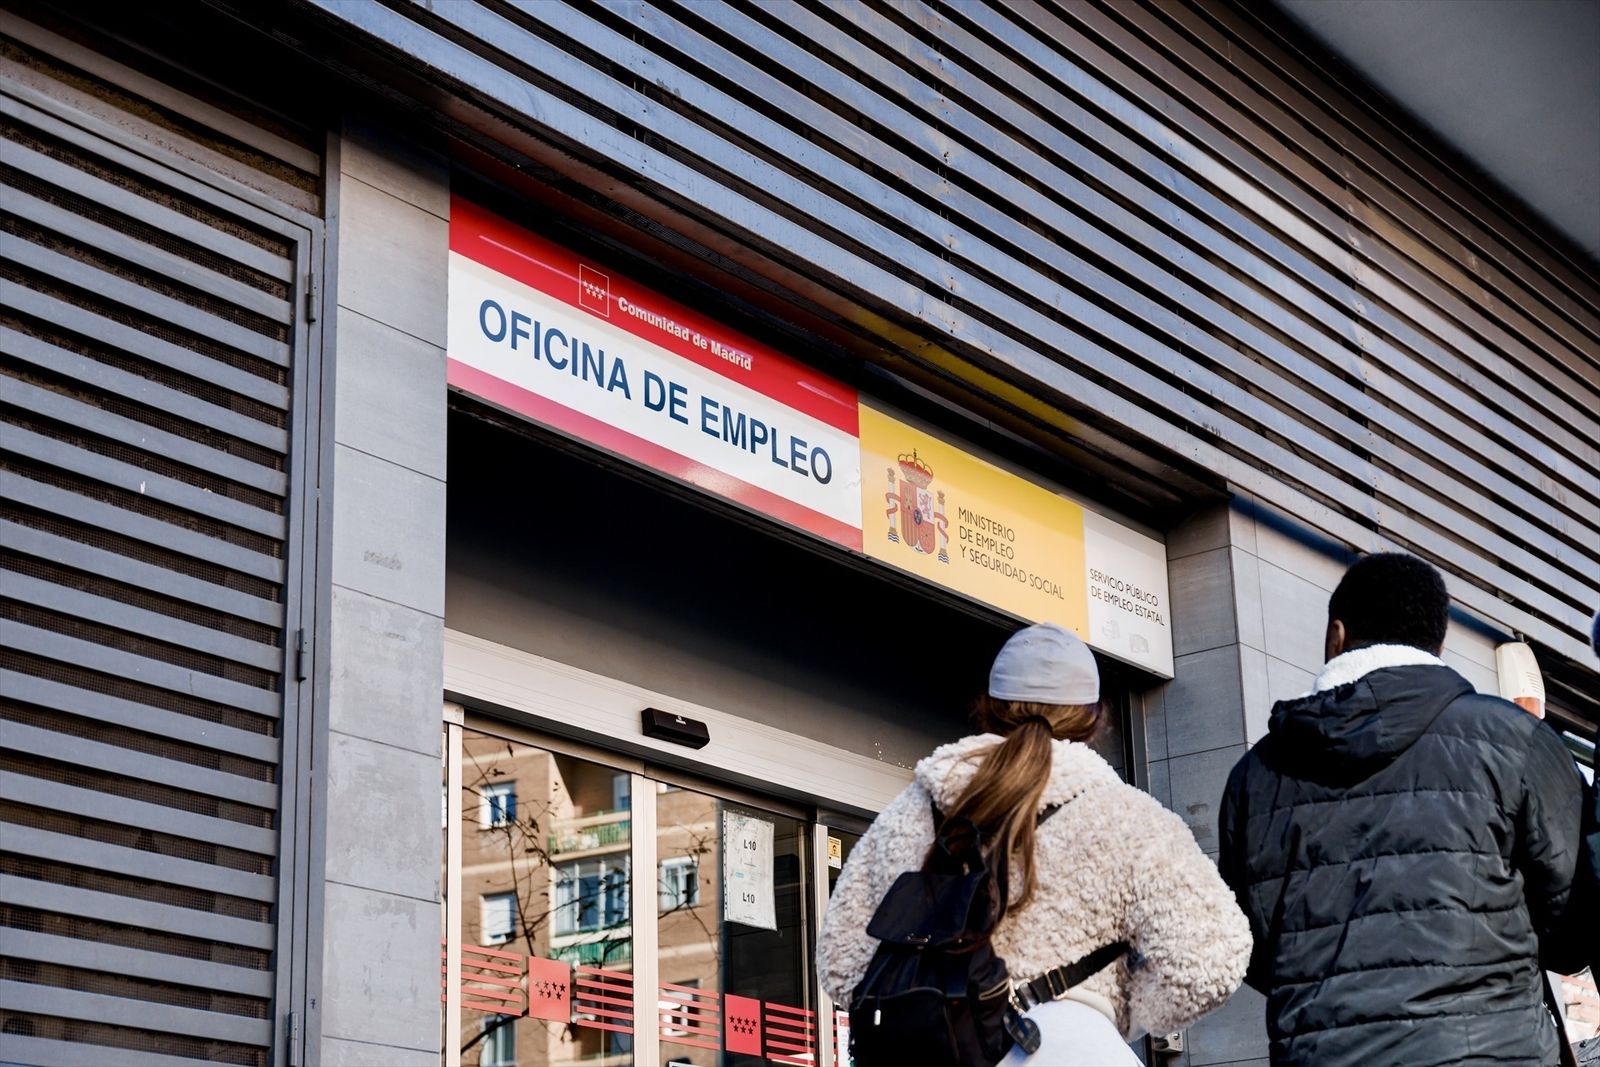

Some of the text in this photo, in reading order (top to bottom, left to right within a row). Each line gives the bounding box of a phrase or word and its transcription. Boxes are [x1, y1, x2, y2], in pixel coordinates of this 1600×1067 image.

[618, 297, 752, 371] Comunidad de Madrid
[479, 298, 833, 485] OFICINA DE EMPLEO
[958, 506, 1015, 542] MINISTERIO
[959, 525, 1014, 560] DE EMPLEO
[960, 544, 1064, 600] Y SEGURIDAD SOCIAL
[1090, 568, 1159, 607] SERVICIO PÚBLICO
[1091, 585, 1165, 626] DE EMPLEO ESTATAL
[743, 839, 757, 851] L10
[742, 892, 755, 904] L10
